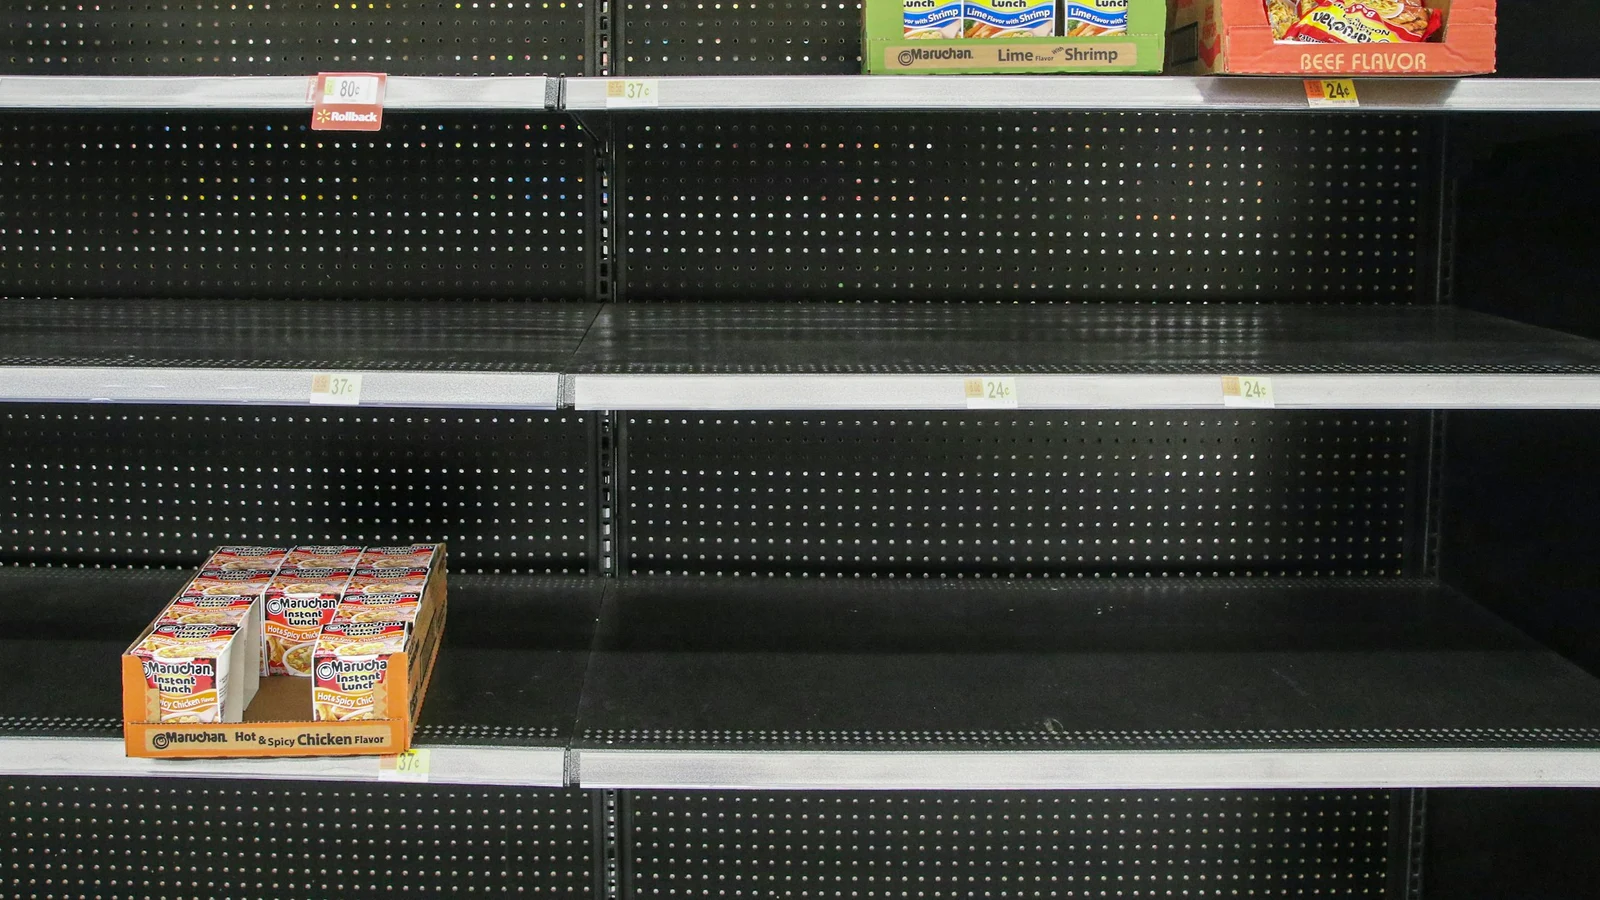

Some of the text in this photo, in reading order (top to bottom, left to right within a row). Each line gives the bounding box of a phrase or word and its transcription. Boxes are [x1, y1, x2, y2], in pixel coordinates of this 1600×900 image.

[928, 8, 958, 22] Shrimp
[967, 8, 987, 19] Lime
[987, 16, 1005, 24] Flavor
[1019, 9, 1050, 23] Shrimp
[1070, 8, 1091, 19] Lime
[1091, 16, 1109, 24] Flavor
[1312, 11, 1374, 43] aruchan
[911, 47, 972, 60] Maruchan
[998, 49, 1034, 62] Lime
[1065, 47, 1118, 63] Shrimp
[1300, 53, 1427, 70] BEEF FLAVOR
[1326, 82, 1350, 98] 24¢
[331, 111, 378, 122] Rollback
[280, 598, 336, 609] Maruchan
[284, 610, 323, 618] Instant
[288, 618, 319, 626] Lunch
[149, 661, 212, 675] Maruchan
[332, 660, 387, 672] Marucha
[153, 675, 196, 685] Instant
[336, 672, 381, 683] Instant
[159, 684, 192, 694] Lunch
[160, 698, 171, 709] icy
[172, 698, 201, 709] Chicken
[166, 731, 385, 748] Maruchan Hot & Spicy Chicken Flavor
